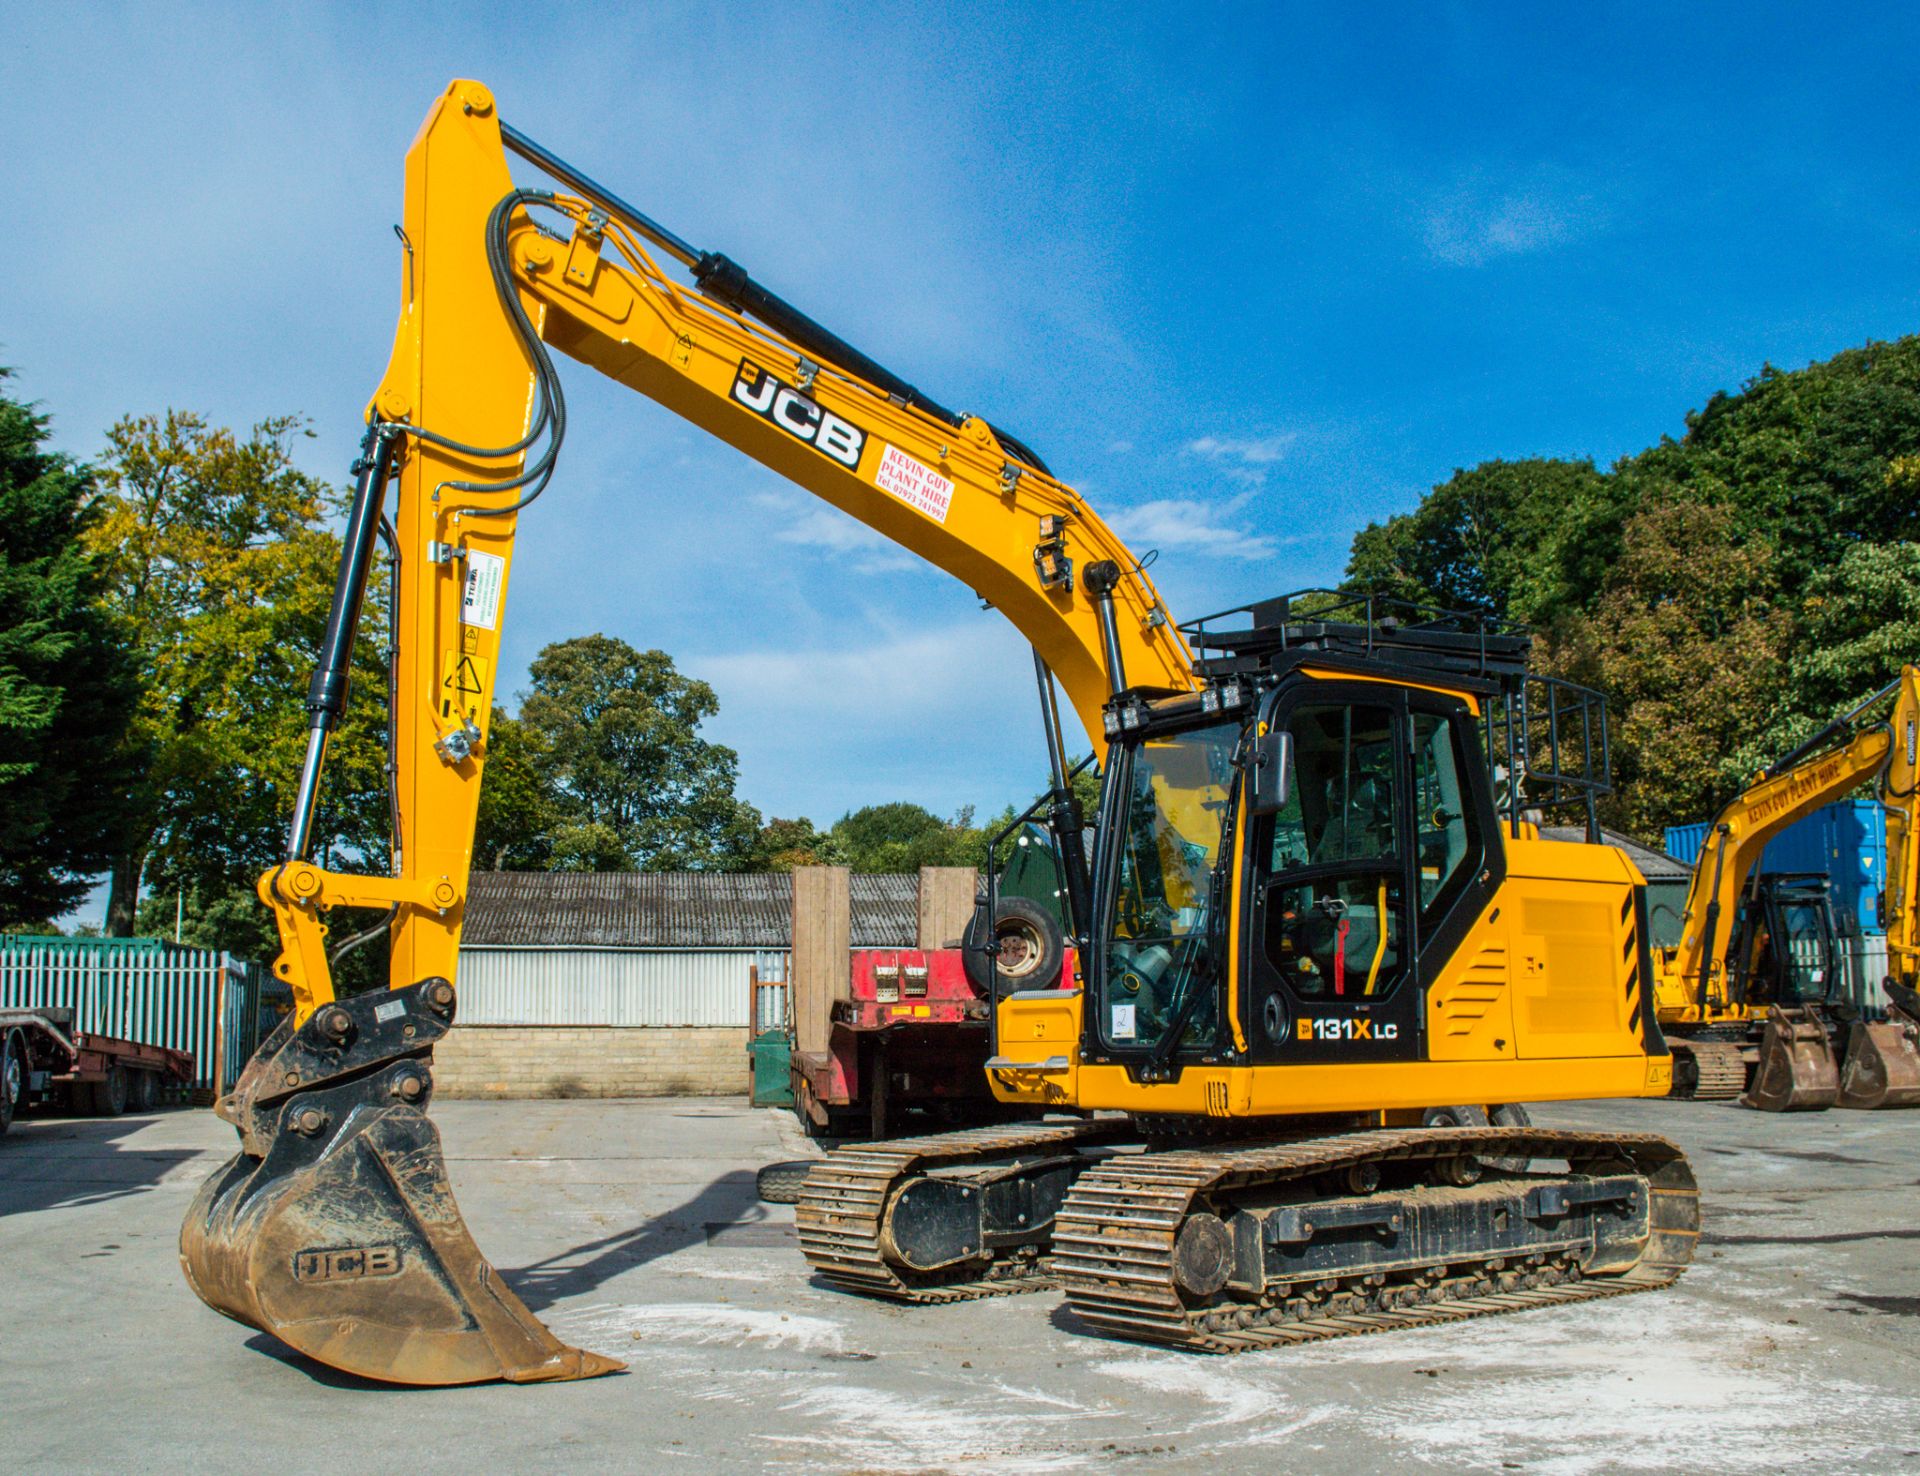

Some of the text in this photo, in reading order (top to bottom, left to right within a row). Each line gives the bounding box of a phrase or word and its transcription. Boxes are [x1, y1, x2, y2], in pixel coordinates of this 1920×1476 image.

[735, 375, 862, 466] JCB
[881, 461, 949, 509] PLANT HIRE
[889, 449, 950, 493] KEVIN GUY
[1790, 772, 1817, 802] PLANT
[1818, 760, 1841, 787] HIRE
[1313, 1019, 1372, 1040] 131X
[1374, 1023, 1398, 1040] LC
[298, 1246, 399, 1281] JCB
